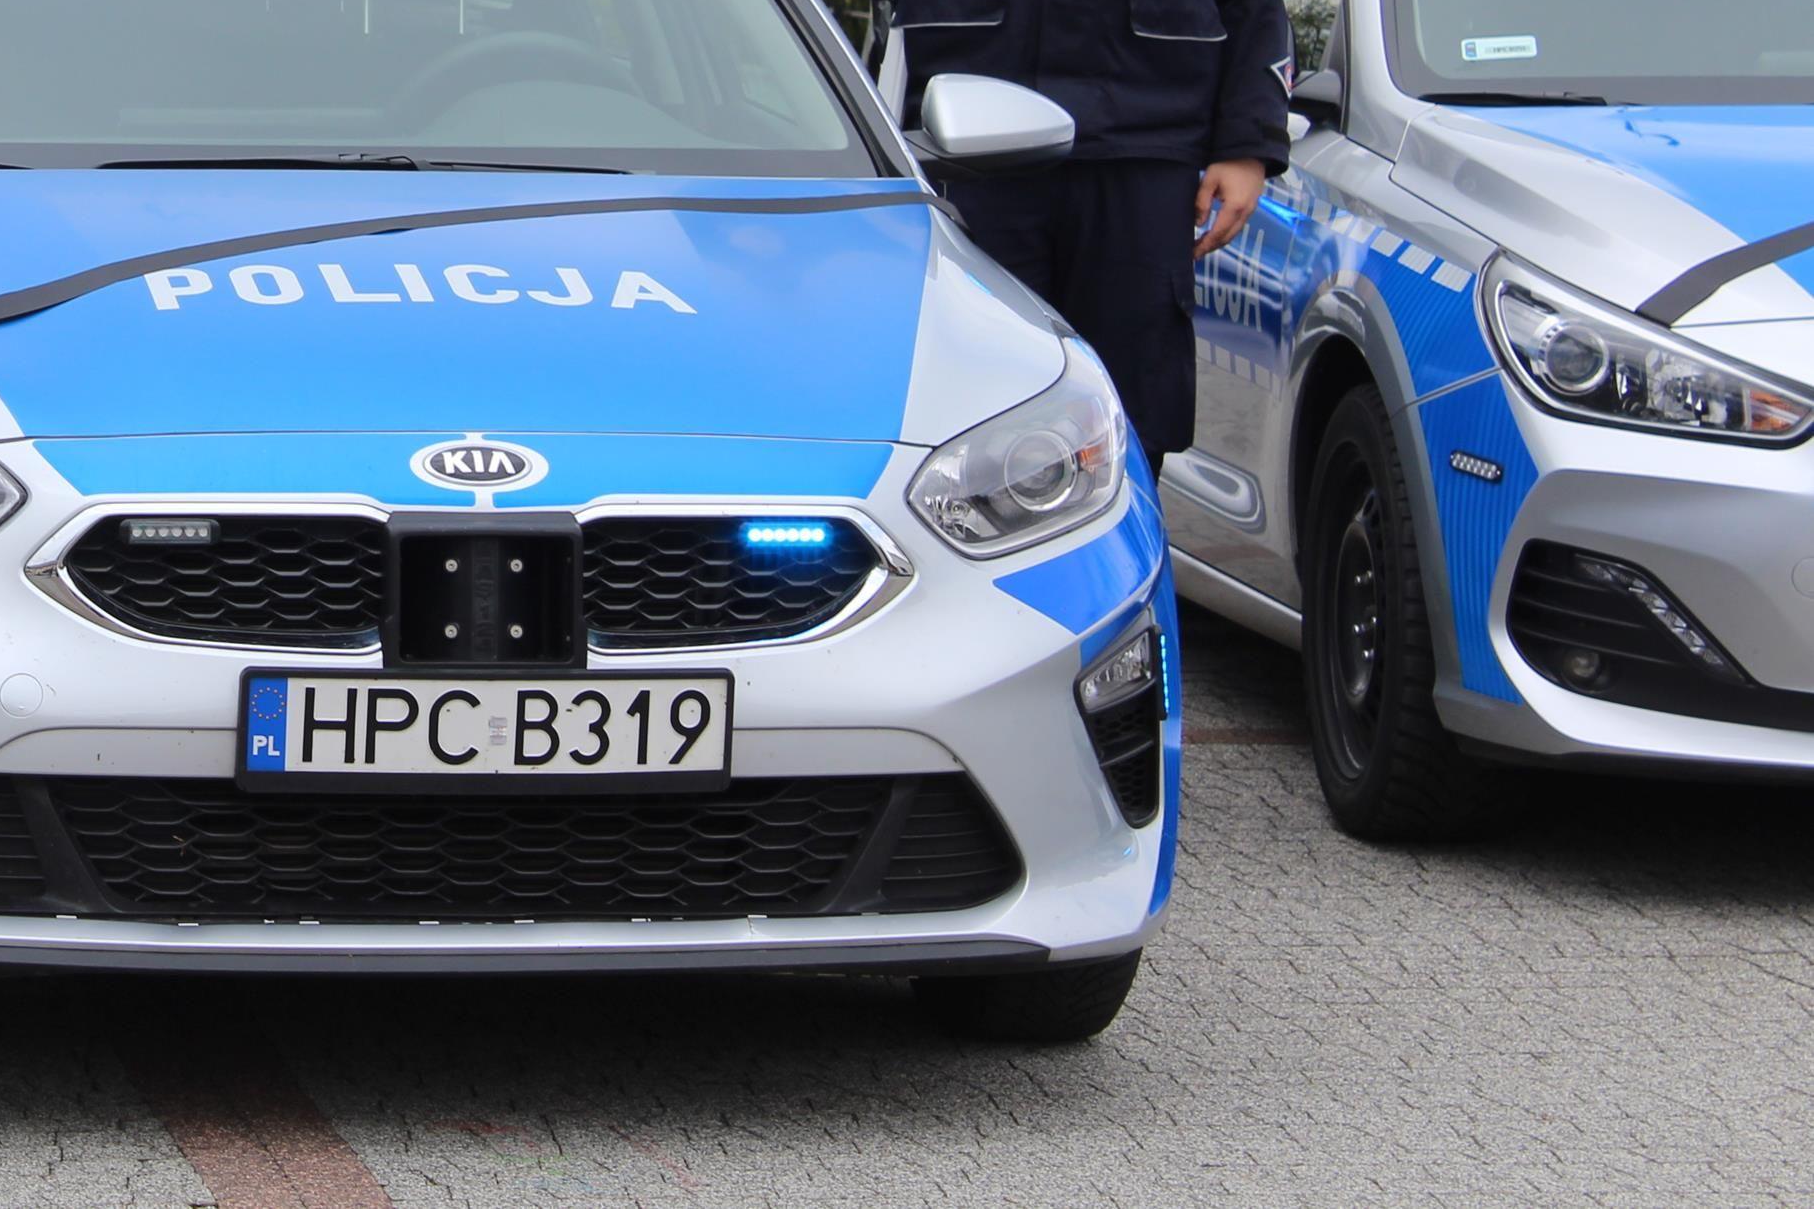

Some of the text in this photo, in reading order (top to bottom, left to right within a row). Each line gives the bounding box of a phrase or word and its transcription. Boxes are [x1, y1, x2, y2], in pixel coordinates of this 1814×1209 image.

[143, 264, 698, 315] POLICJA
[442, 450, 516, 474] KIA
[302, 687, 711, 766] HPC B319
[252, 735, 281, 757] PL
